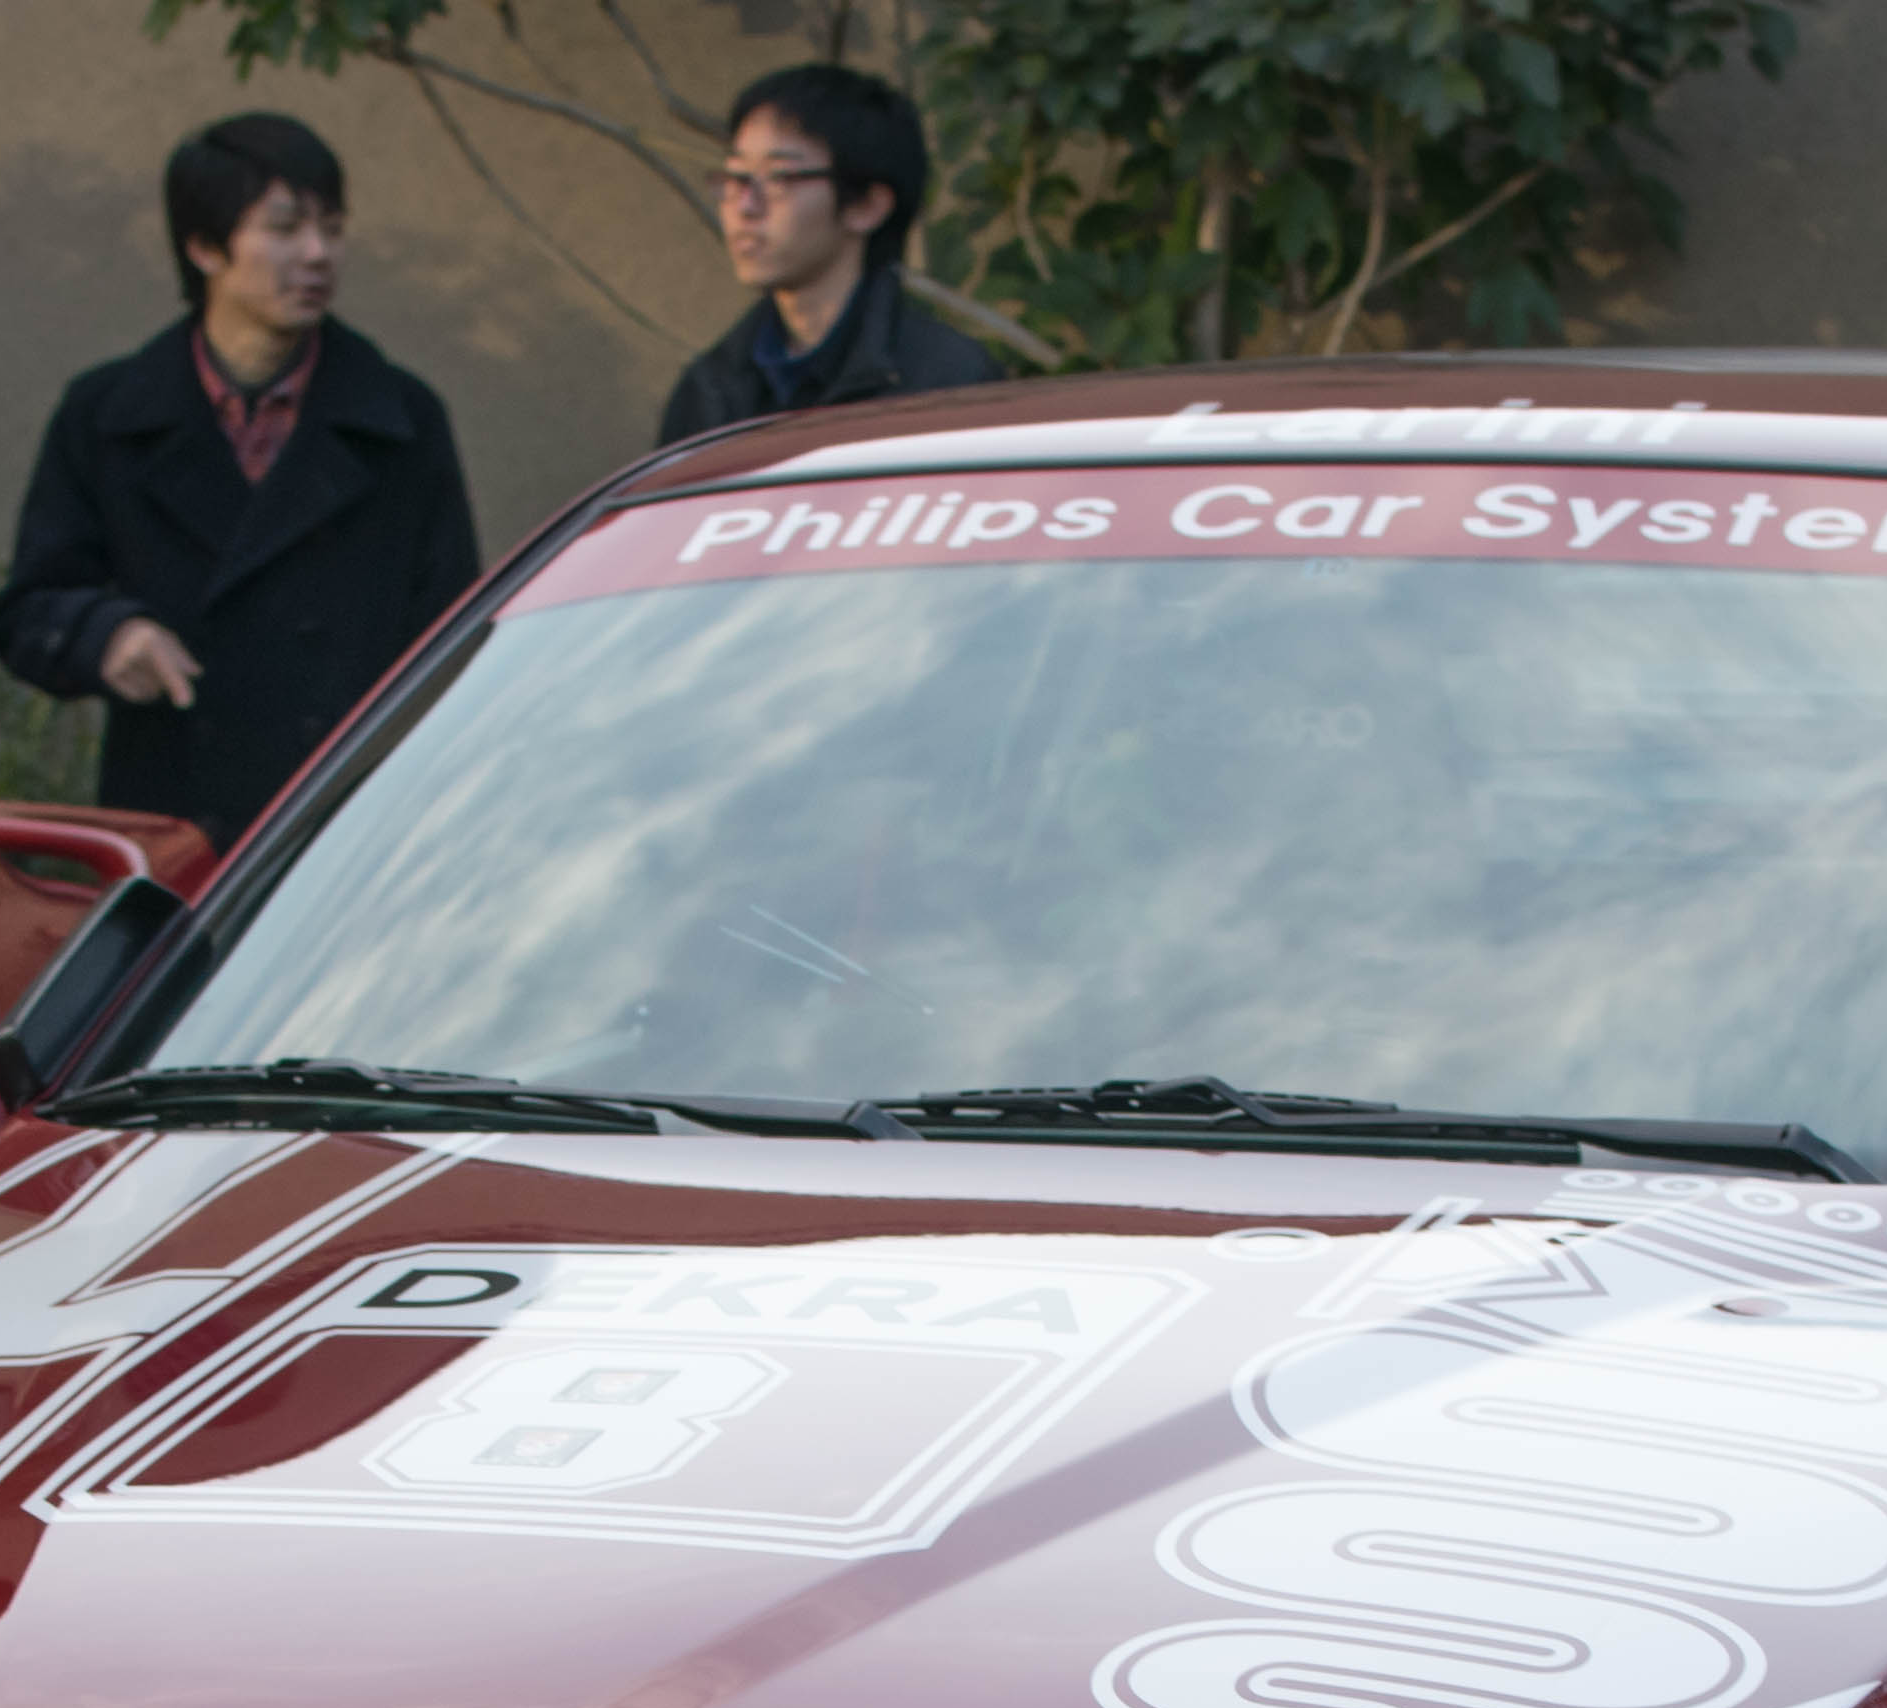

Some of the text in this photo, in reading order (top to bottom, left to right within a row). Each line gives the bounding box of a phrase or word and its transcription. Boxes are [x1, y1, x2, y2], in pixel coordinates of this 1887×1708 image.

[677, 491, 1116, 563] Philips
[1169, 484, 1424, 540] Car
[357, 1267, 1083, 1335] DEKRA
[359, 1344, 793, 1498] 8
